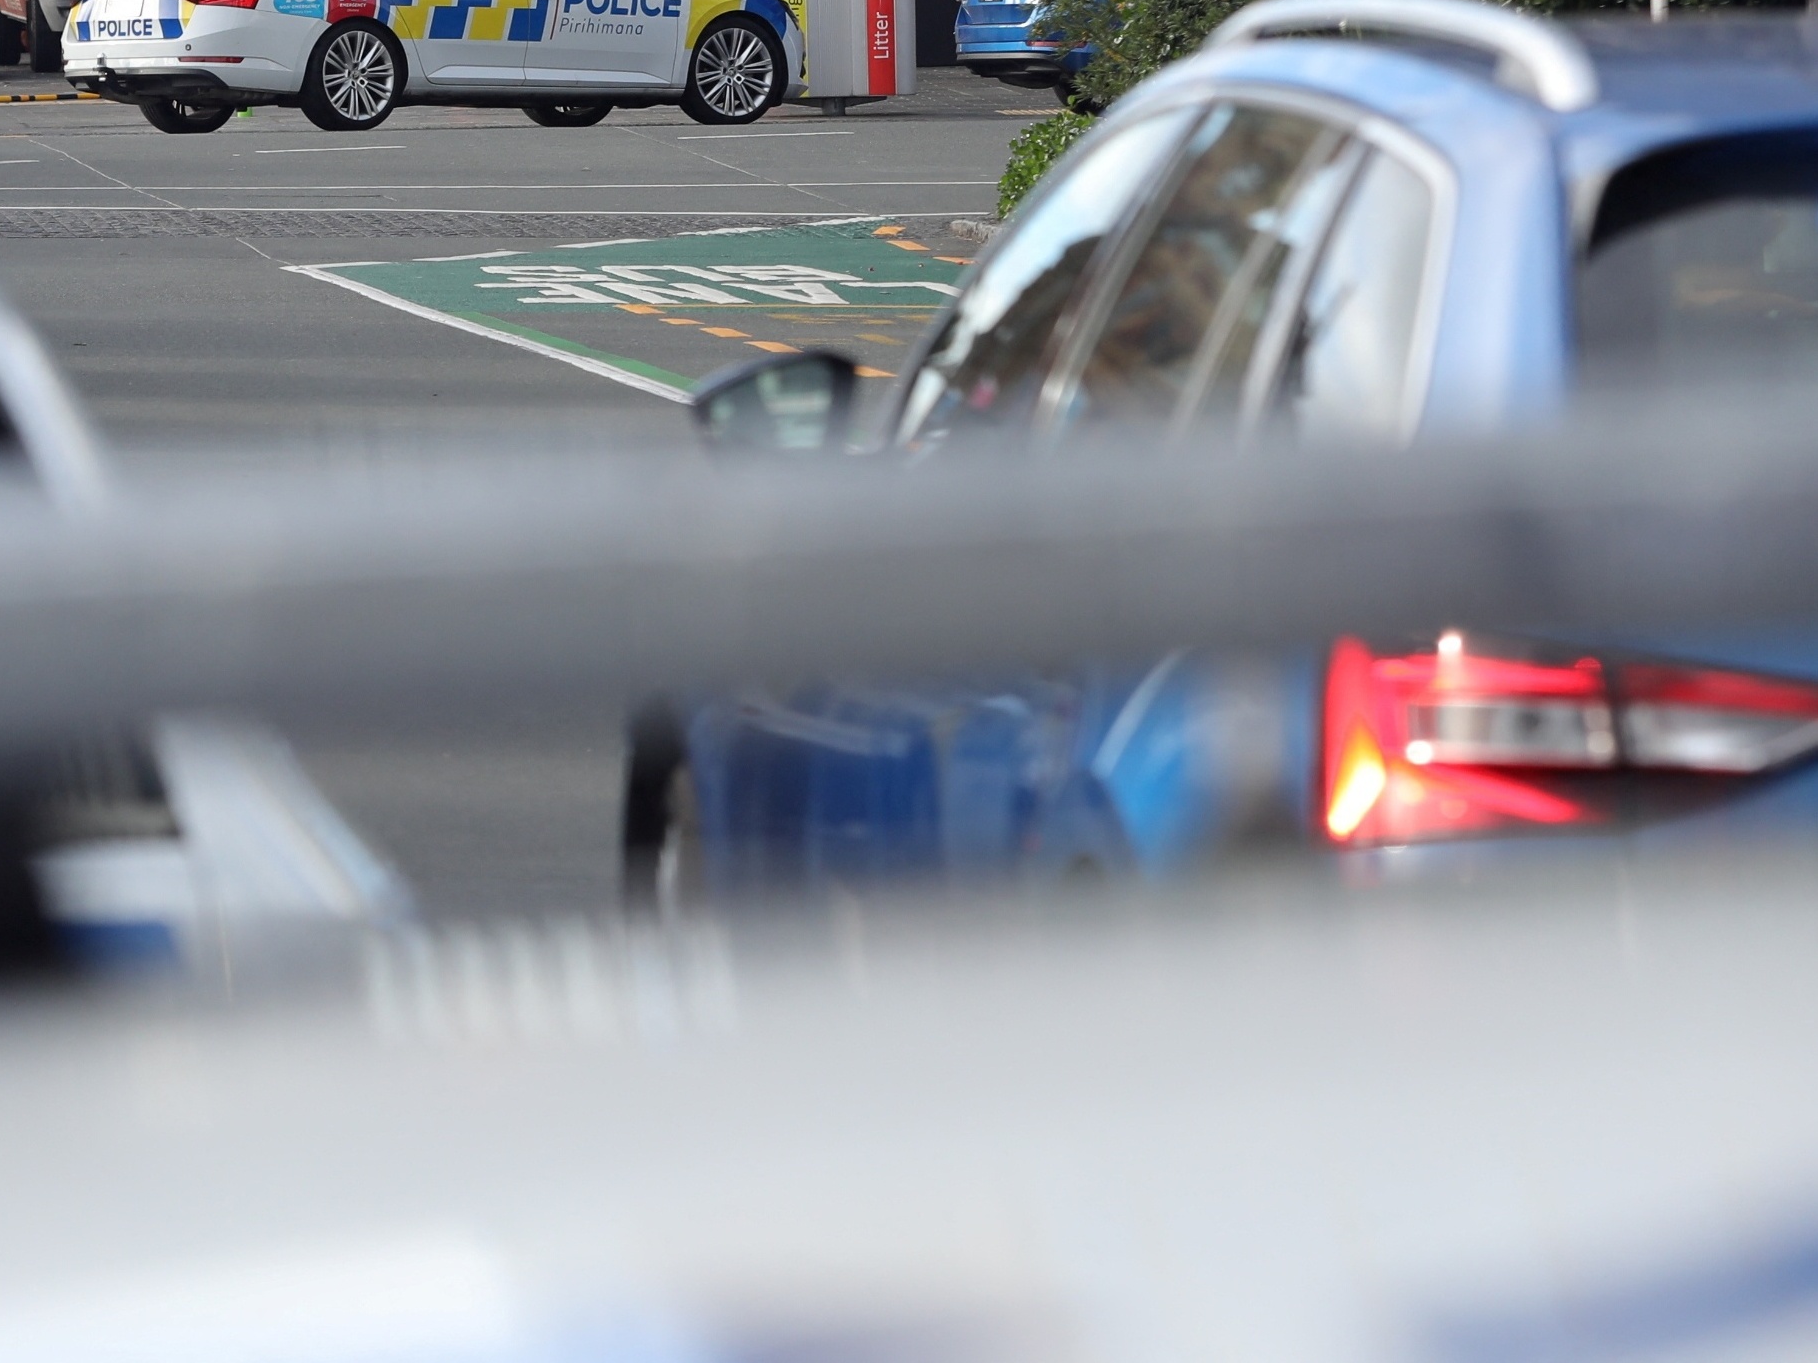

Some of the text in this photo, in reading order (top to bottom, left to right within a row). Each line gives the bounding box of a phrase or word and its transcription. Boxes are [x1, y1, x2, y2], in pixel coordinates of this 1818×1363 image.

[98, 18, 153, 37] POLICE
[559, 17, 644, 36] Pirihimana
[873, 12, 890, 59] Litter
